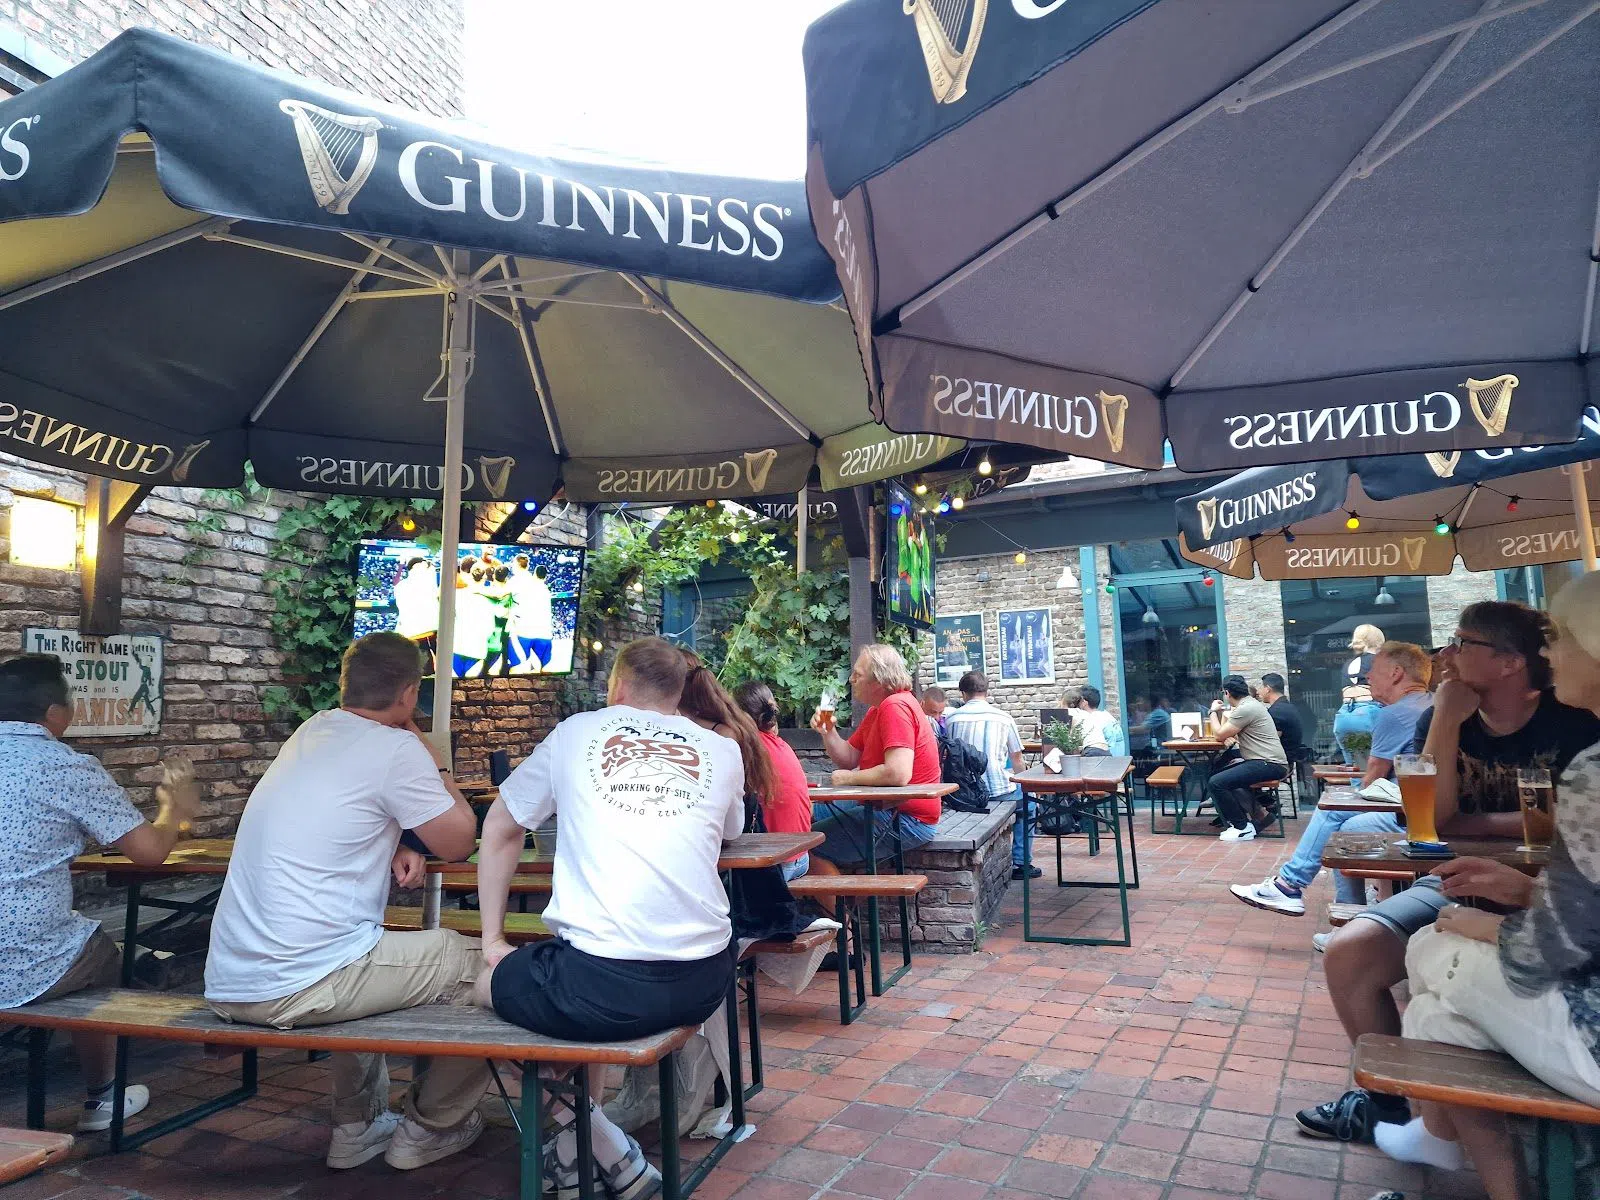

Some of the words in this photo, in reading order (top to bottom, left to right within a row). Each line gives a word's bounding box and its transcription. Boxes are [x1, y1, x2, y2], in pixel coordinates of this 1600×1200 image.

[399, 141, 785, 262] GUINNESS
[1219, 472, 1316, 529] GUINNESS
[35, 634, 57, 652] THE
[62, 635, 96, 655] RIGHT
[99, 643, 128, 656] NAME
[60, 662, 72, 675] OR
[76, 660, 129, 681] STOUT
[71, 698, 144, 727] AMISH
[587, 739, 599, 762] 1922
[610, 783, 650, 793] WORKING
[603, 793, 645, 816] DICKIES
